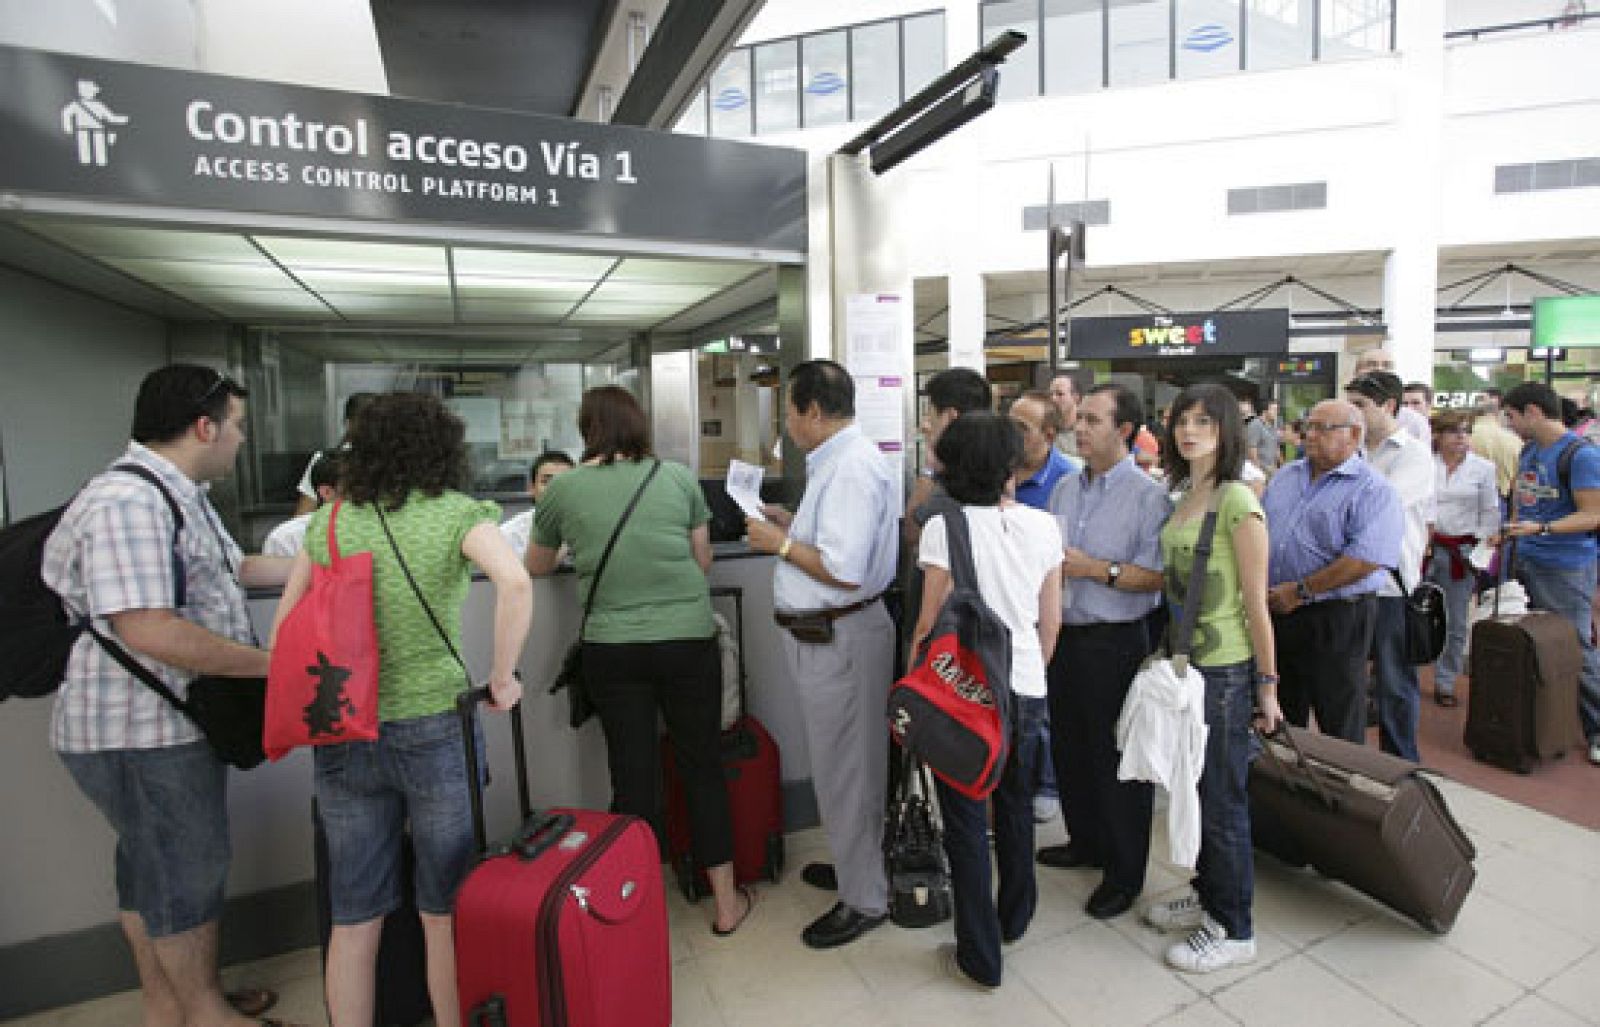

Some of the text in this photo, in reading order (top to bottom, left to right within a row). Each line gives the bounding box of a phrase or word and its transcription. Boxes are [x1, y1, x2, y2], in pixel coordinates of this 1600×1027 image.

[186, 100, 638, 184] Control acceso Vía 1
[195, 154, 560, 207] ACCESS CONTROL PLATFORM 1
[1129, 319, 1217, 347] sweet
